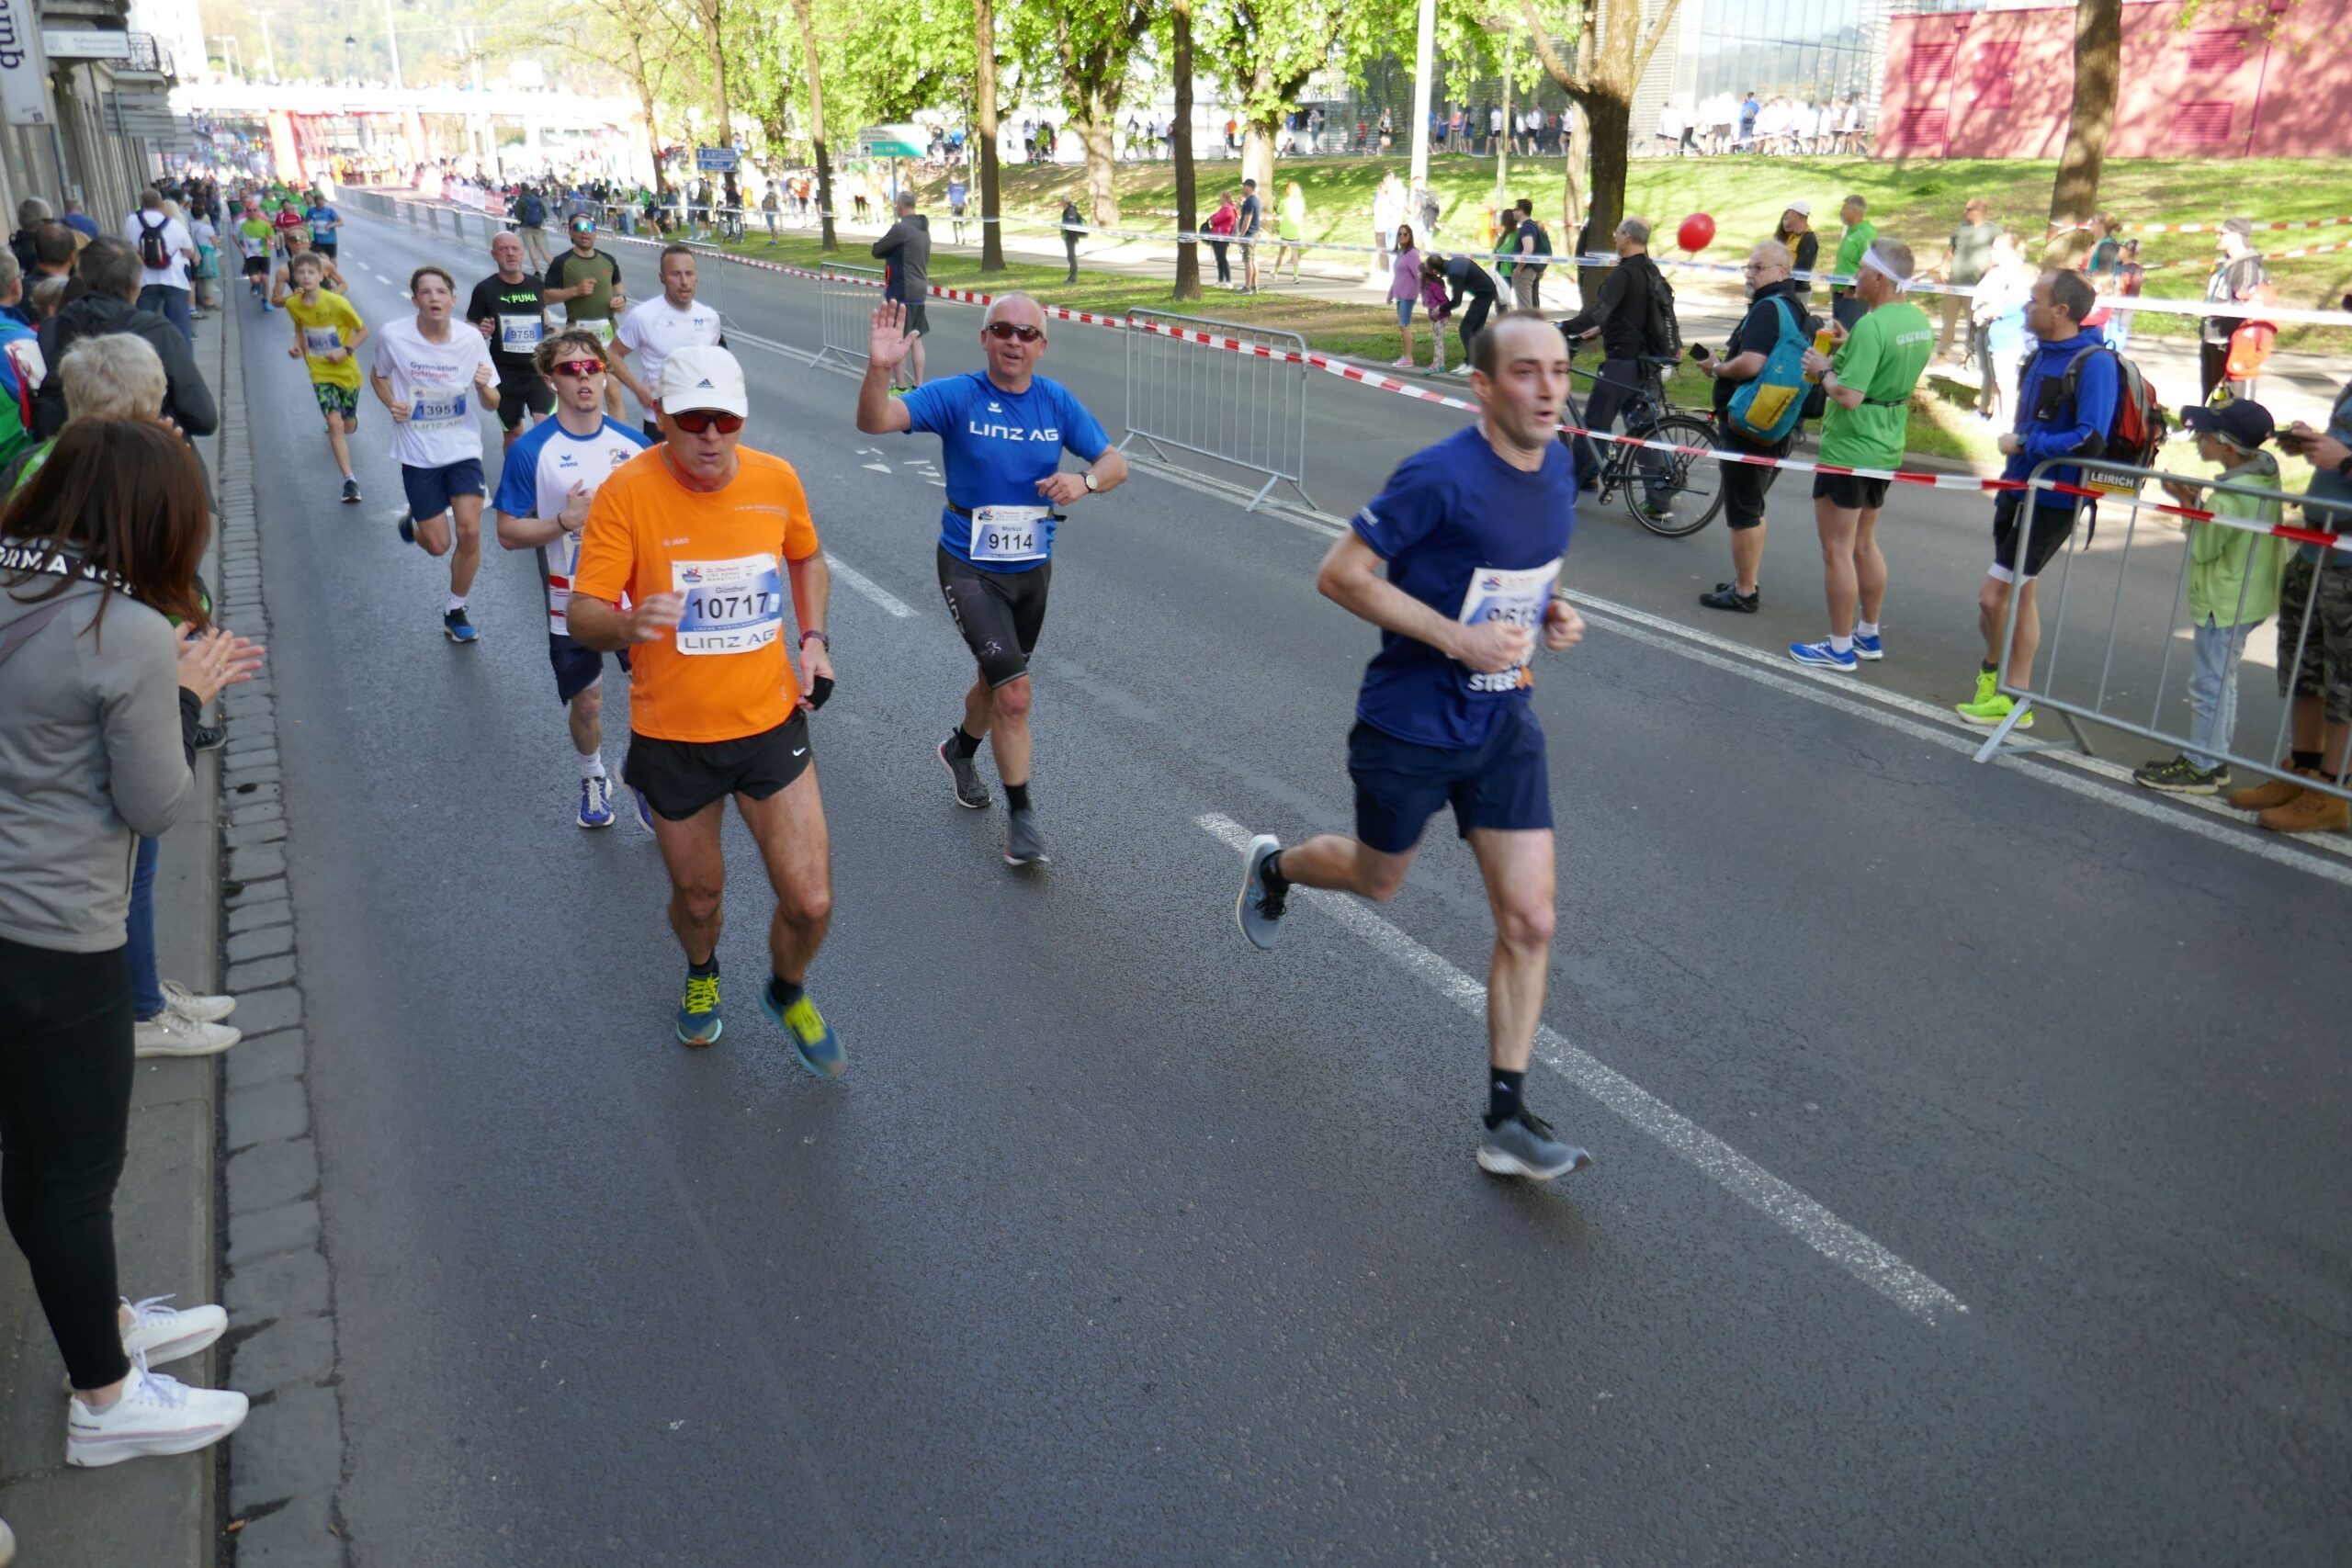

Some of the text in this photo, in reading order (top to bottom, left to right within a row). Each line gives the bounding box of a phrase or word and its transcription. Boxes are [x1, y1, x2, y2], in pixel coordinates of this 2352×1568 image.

[512, 293, 538, 303] PUMA
[510, 330, 536, 339] 9758
[410, 361, 458, 372] Gymnasium
[418, 403, 458, 416] 13951
[969, 421, 1059, 441] LINZ AG
[989, 533, 1033, 550] 9114
[715, 585, 748, 594] Günther
[692, 592, 769, 619] 10717
[684, 628, 775, 649] LINZ AG
